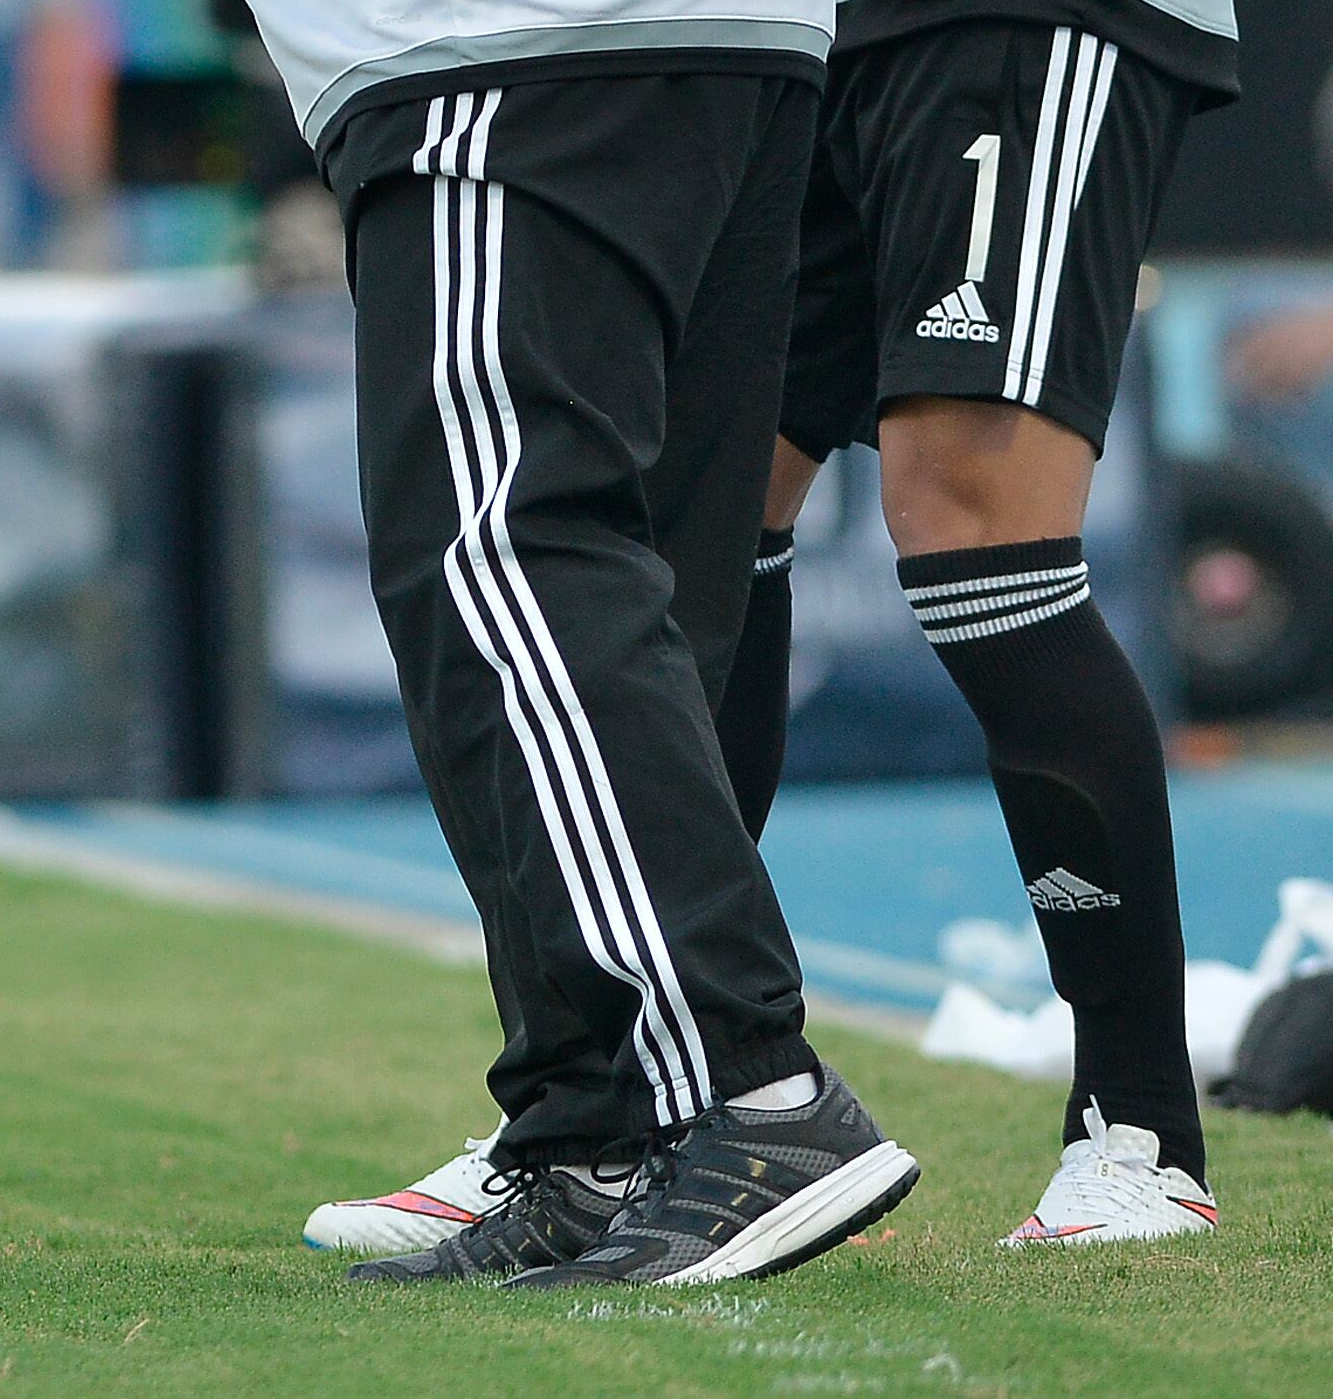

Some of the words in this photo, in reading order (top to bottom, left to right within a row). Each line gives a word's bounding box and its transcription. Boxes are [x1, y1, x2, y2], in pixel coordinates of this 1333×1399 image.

[962, 134, 1001, 282] 1
[916, 316, 1000, 343] adidas
[1027, 892, 1121, 912] didas
